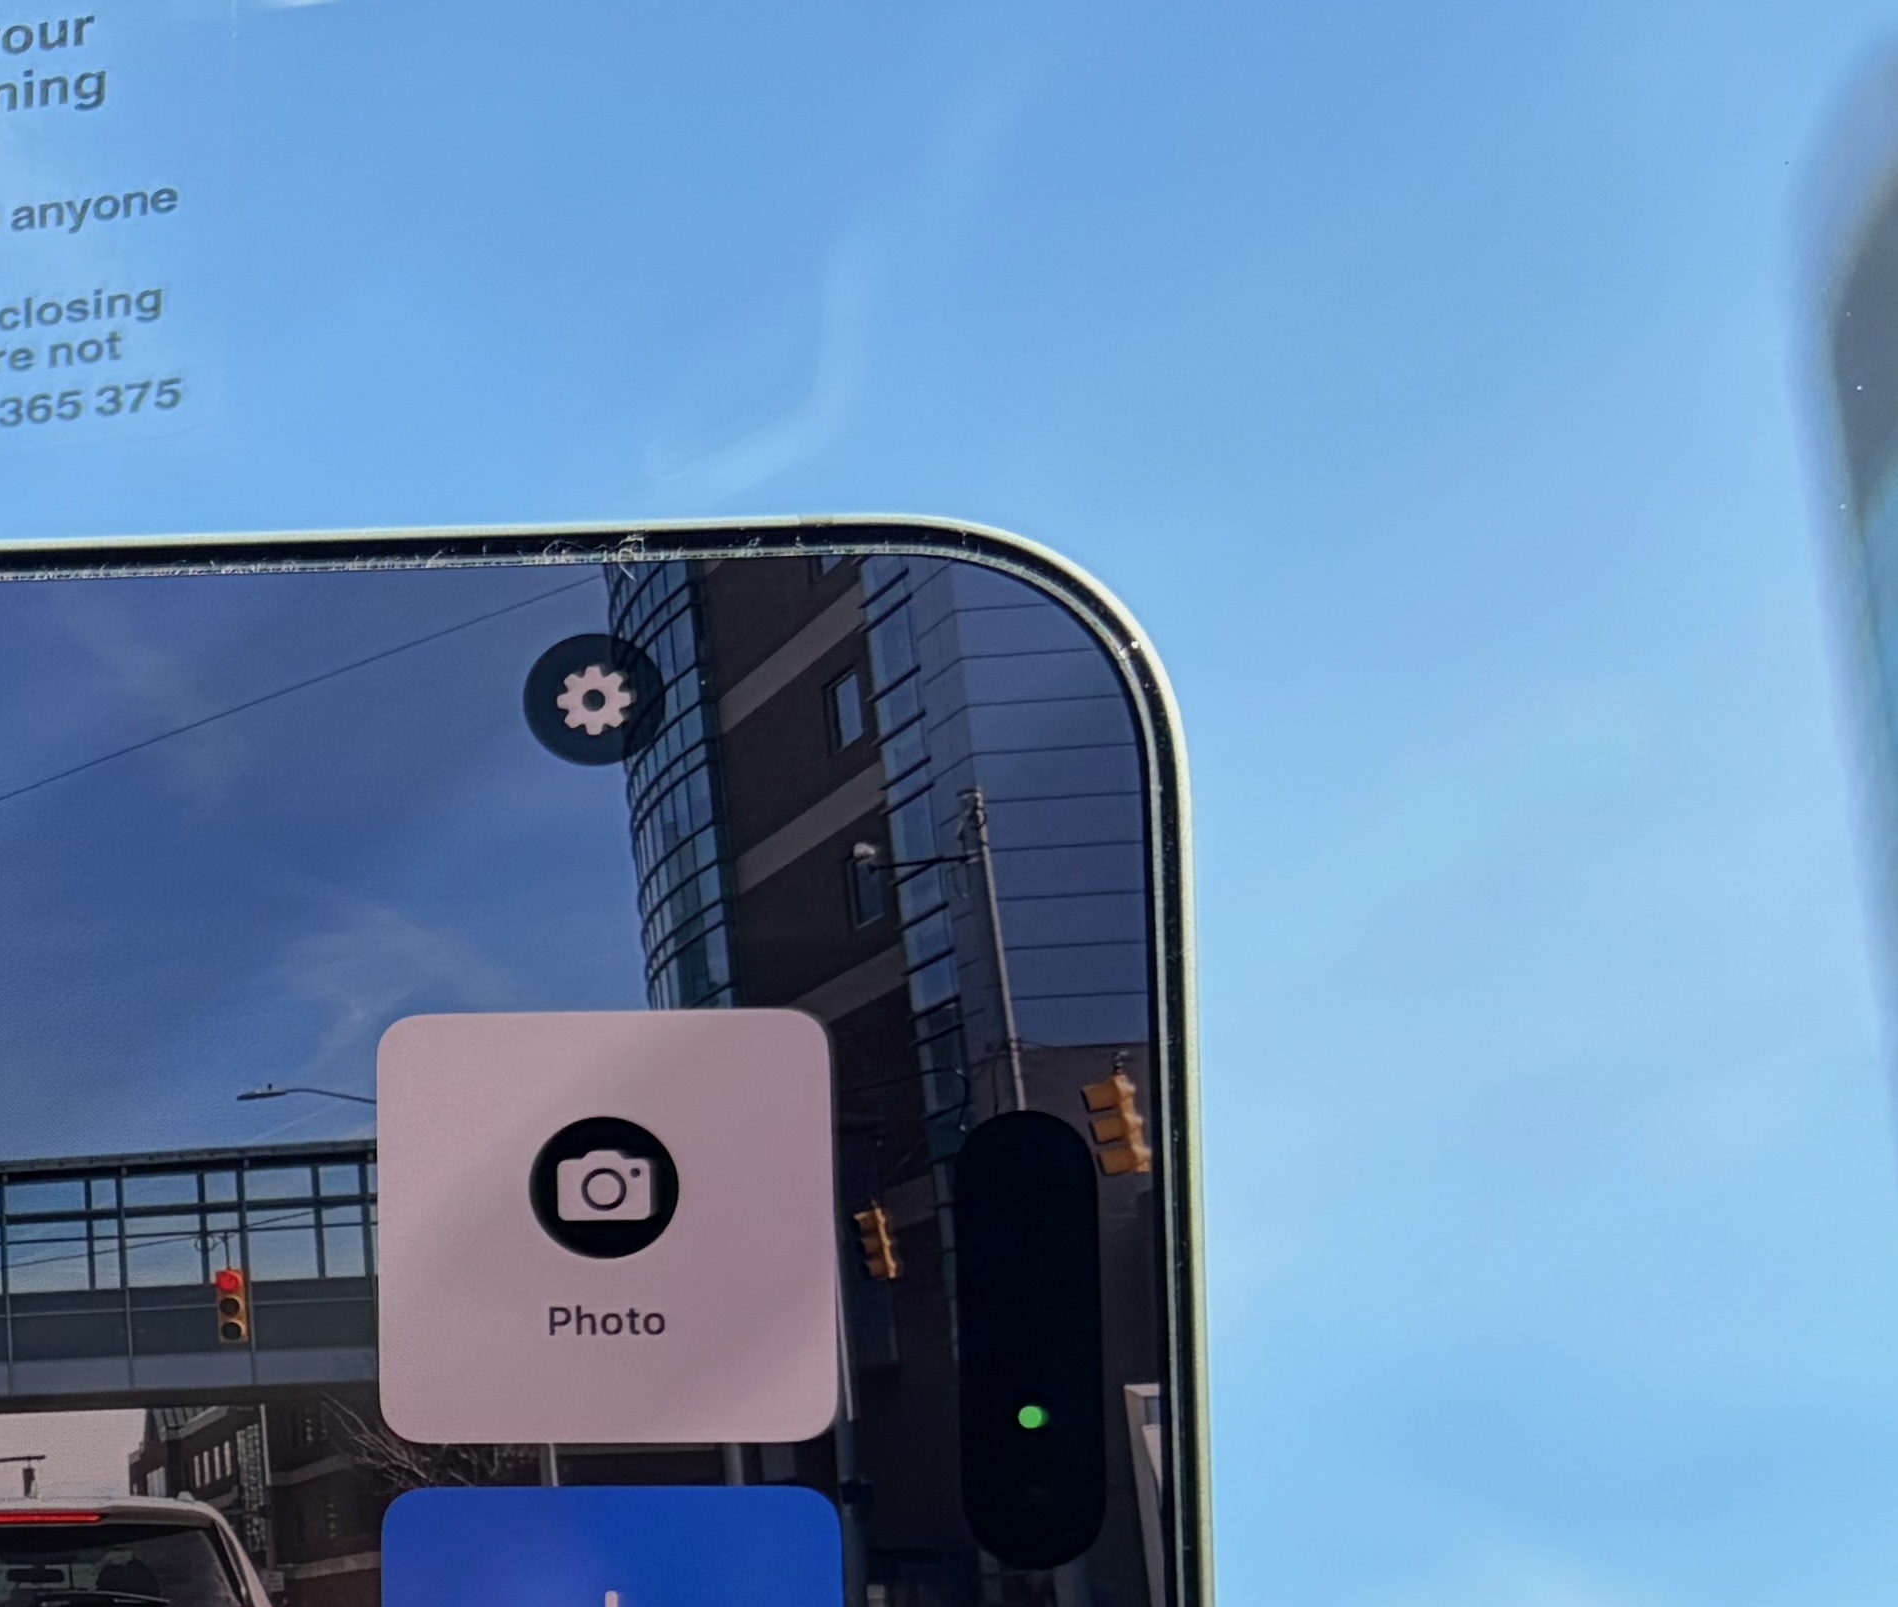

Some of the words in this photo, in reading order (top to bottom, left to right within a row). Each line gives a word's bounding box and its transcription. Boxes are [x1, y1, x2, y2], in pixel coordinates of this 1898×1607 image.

[11, 188, 178, 234] anyone
[49, 331, 121, 368] not
[95, 378, 181, 416] 375
[548, 1304, 667, 1336] Photo
